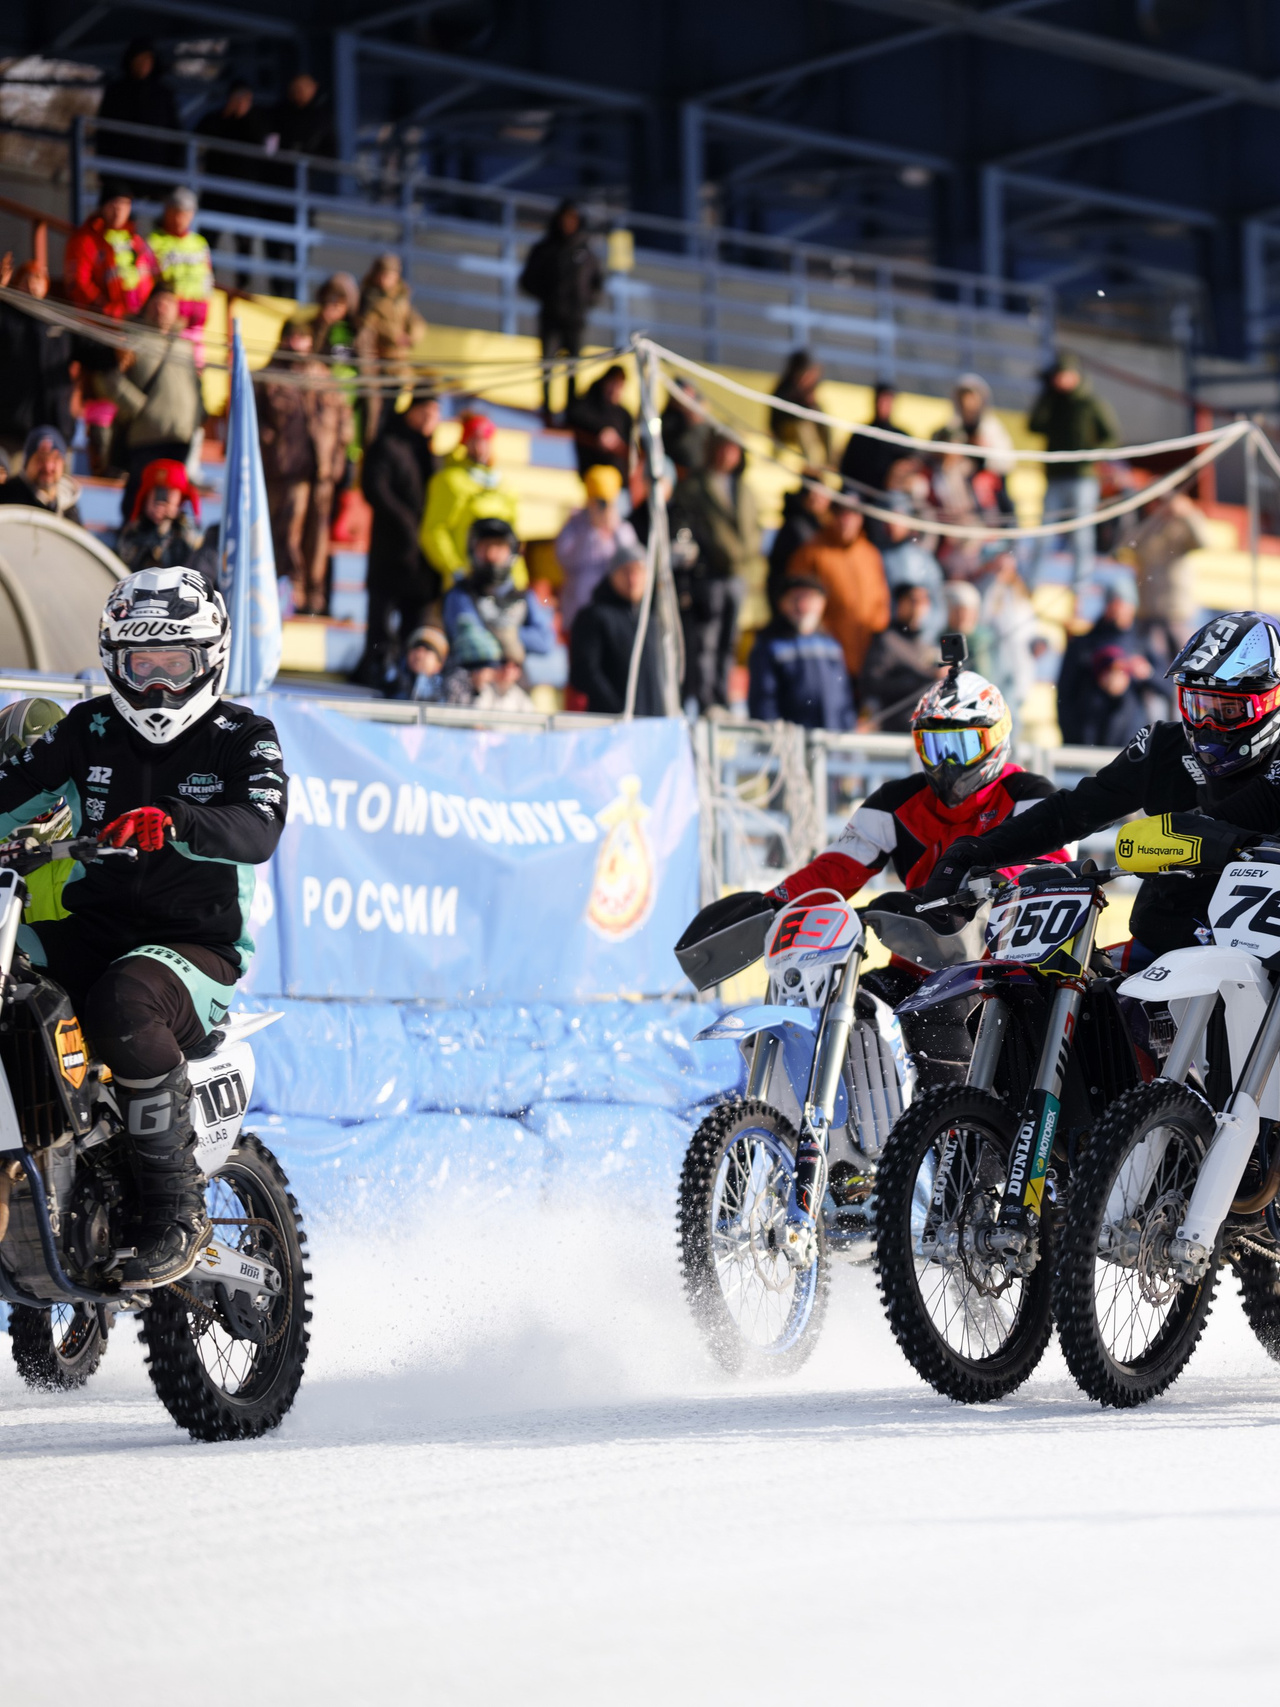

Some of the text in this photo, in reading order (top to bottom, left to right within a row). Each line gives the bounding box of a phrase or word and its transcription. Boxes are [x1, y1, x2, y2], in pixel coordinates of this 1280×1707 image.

[117, 621, 192, 637] HOUSE
[1182, 619, 1239, 671] FXR
[1137, 845, 1184, 857] Husqvarna
[1229, 869, 1269, 878] GUSEV
[303, 876, 458, 936] РОССИИ
[987, 899, 1082, 954] 250
[194, 1069, 249, 1128] 101
[1038, 1109, 1057, 1159] MOTOREX
